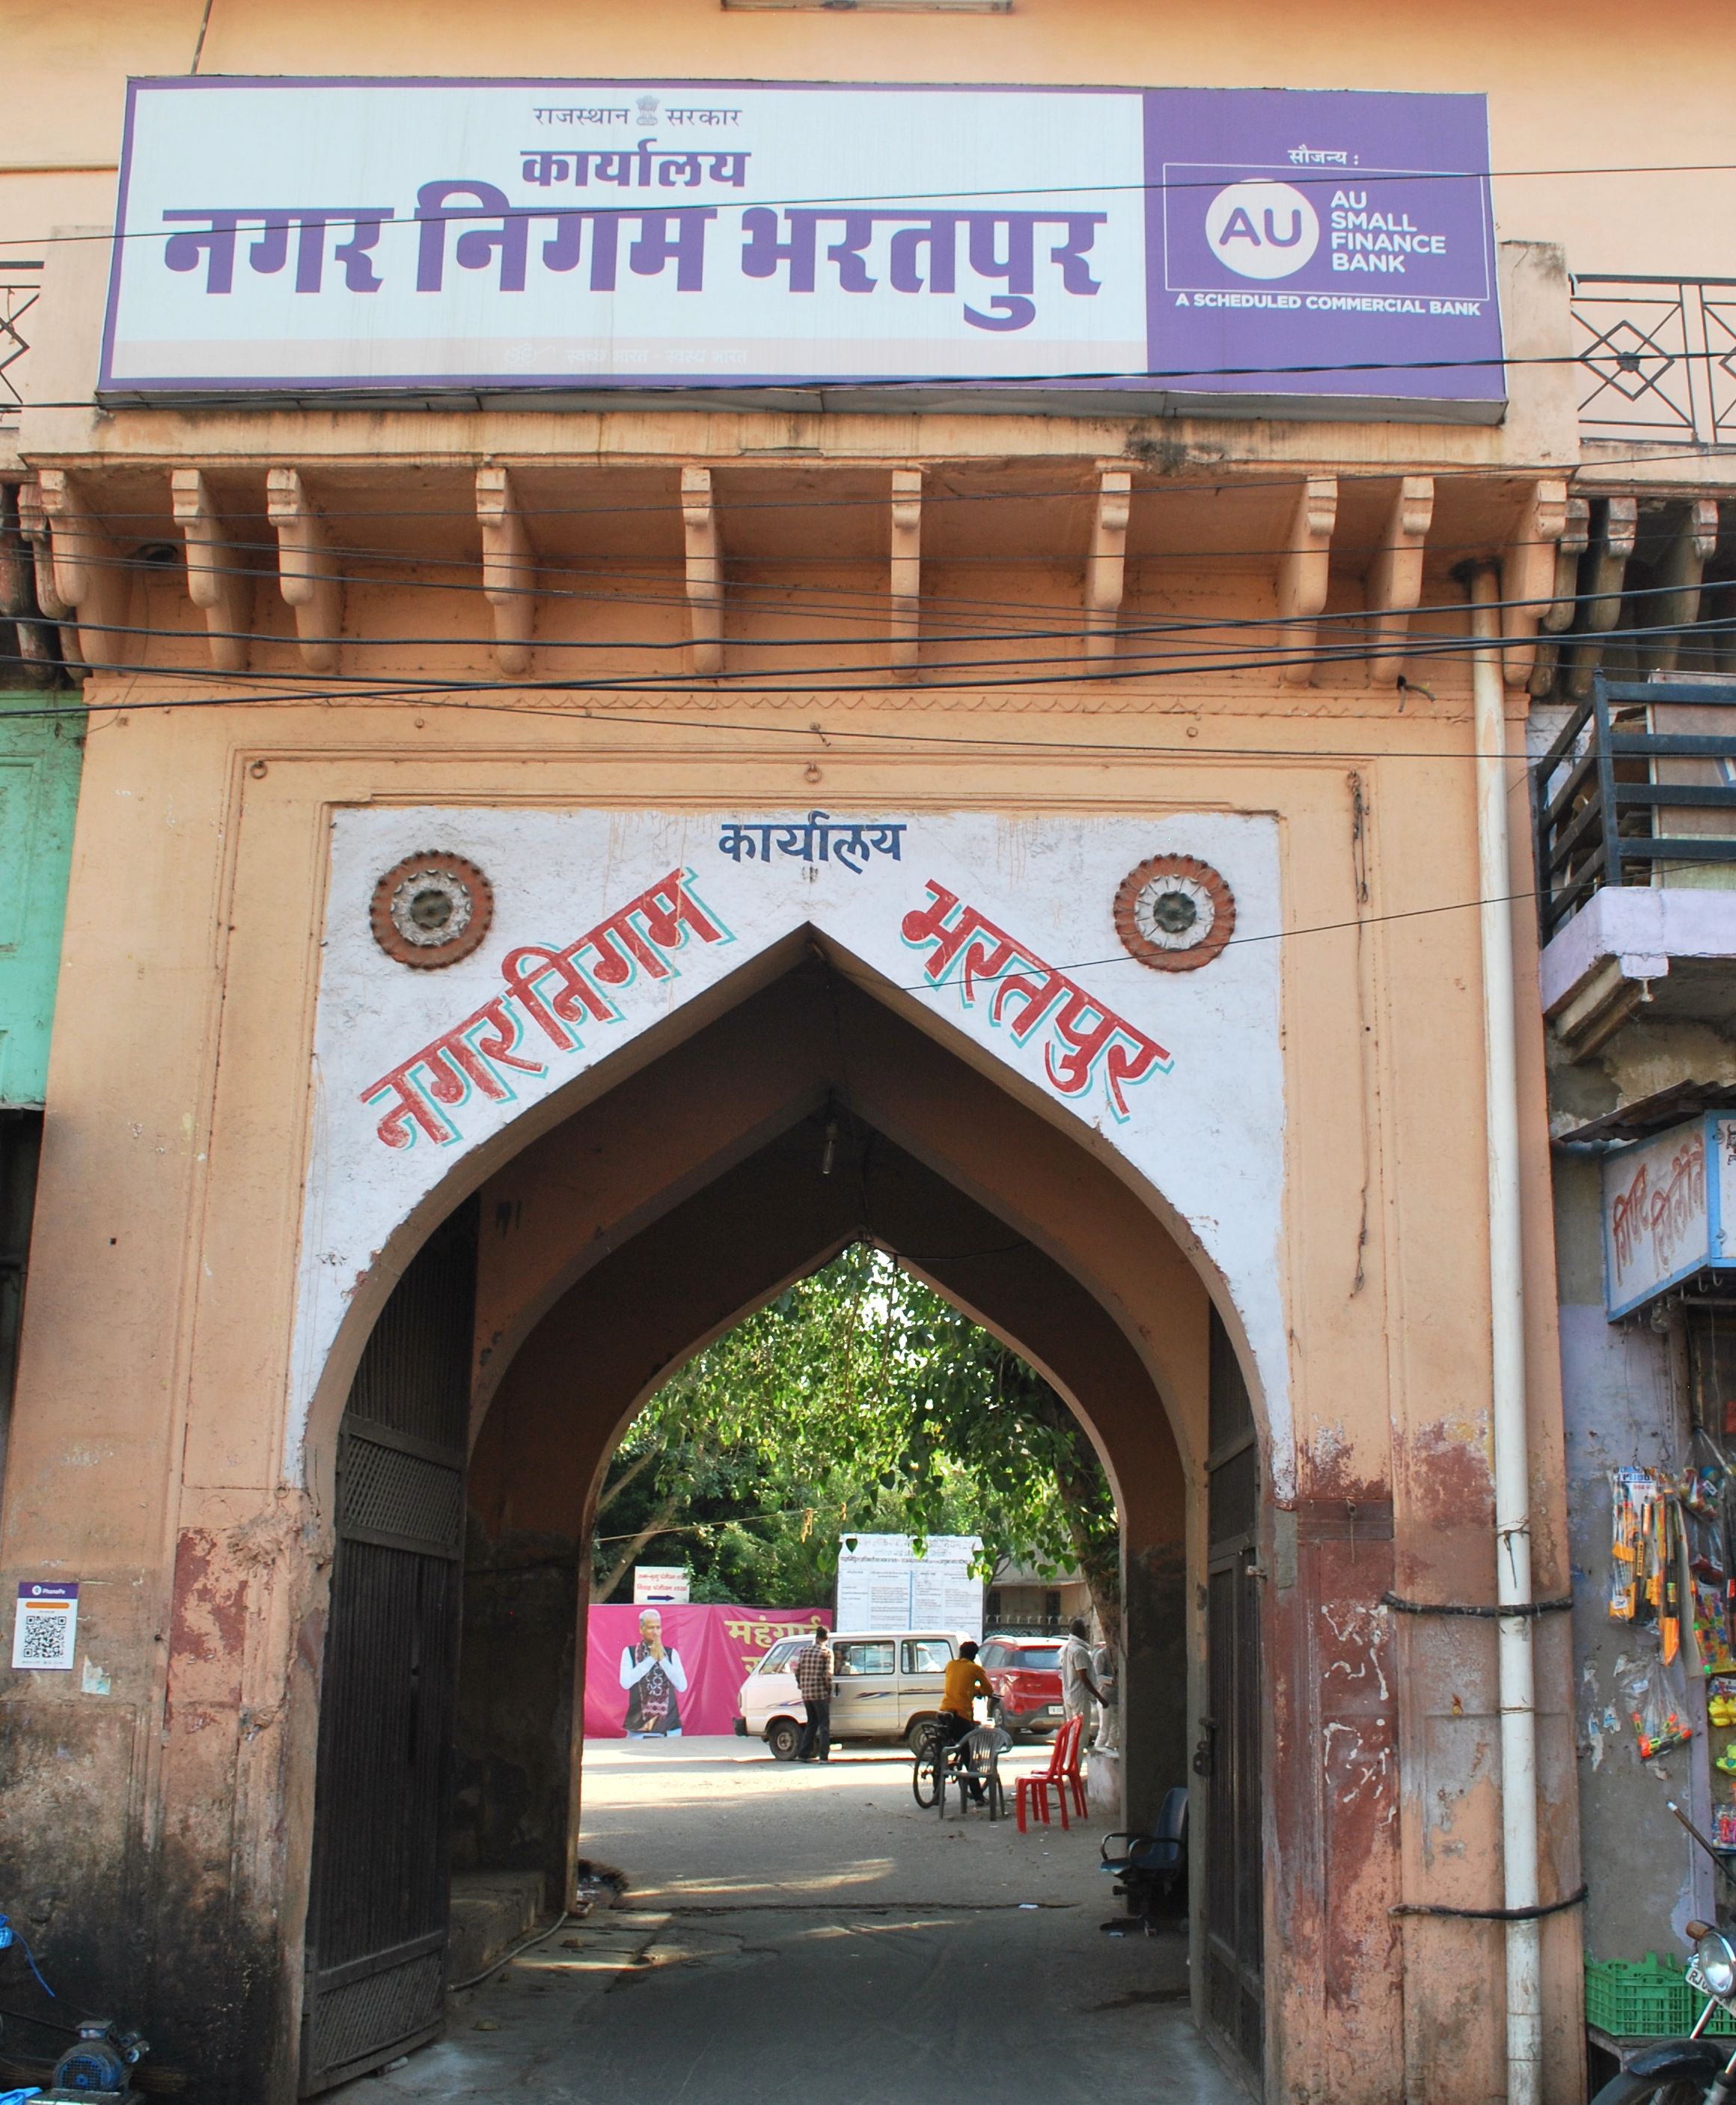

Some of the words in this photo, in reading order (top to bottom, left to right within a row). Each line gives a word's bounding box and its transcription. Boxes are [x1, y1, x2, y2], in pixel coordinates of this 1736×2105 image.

[533, 109, 630, 124] राजस्थान
[665, 109, 742, 126] सरकार
[520, 138, 751, 187] कार्यालय
[1288, 144, 1347, 165] सौजन्य
[1330, 190, 1367, 210] AU
[1219, 207, 1302, 248] AU
[1330, 211, 1417, 233] SMALL
[1331, 232, 1446, 254] FINANCE
[162, 207, 395, 294] नगर
[414, 178, 718, 293] निगम
[741, 207, 1107, 332] भरतपुर
[1332, 253, 1405, 273] BANK
[1175, 293, 1190, 307] A
[1194, 293, 1301, 310] SCHEDULED
[1305, 296, 1425, 314] COMMERCIAL
[1429, 301, 1481, 317] BANK
[711, 349, 750, 364] भारत
[718, 810, 907, 874] कार्यालय
[360, 995, 548, 1151] नगर
[501, 867, 737, 1054] निगम
[900, 878, 1175, 1125] भरतपुर
